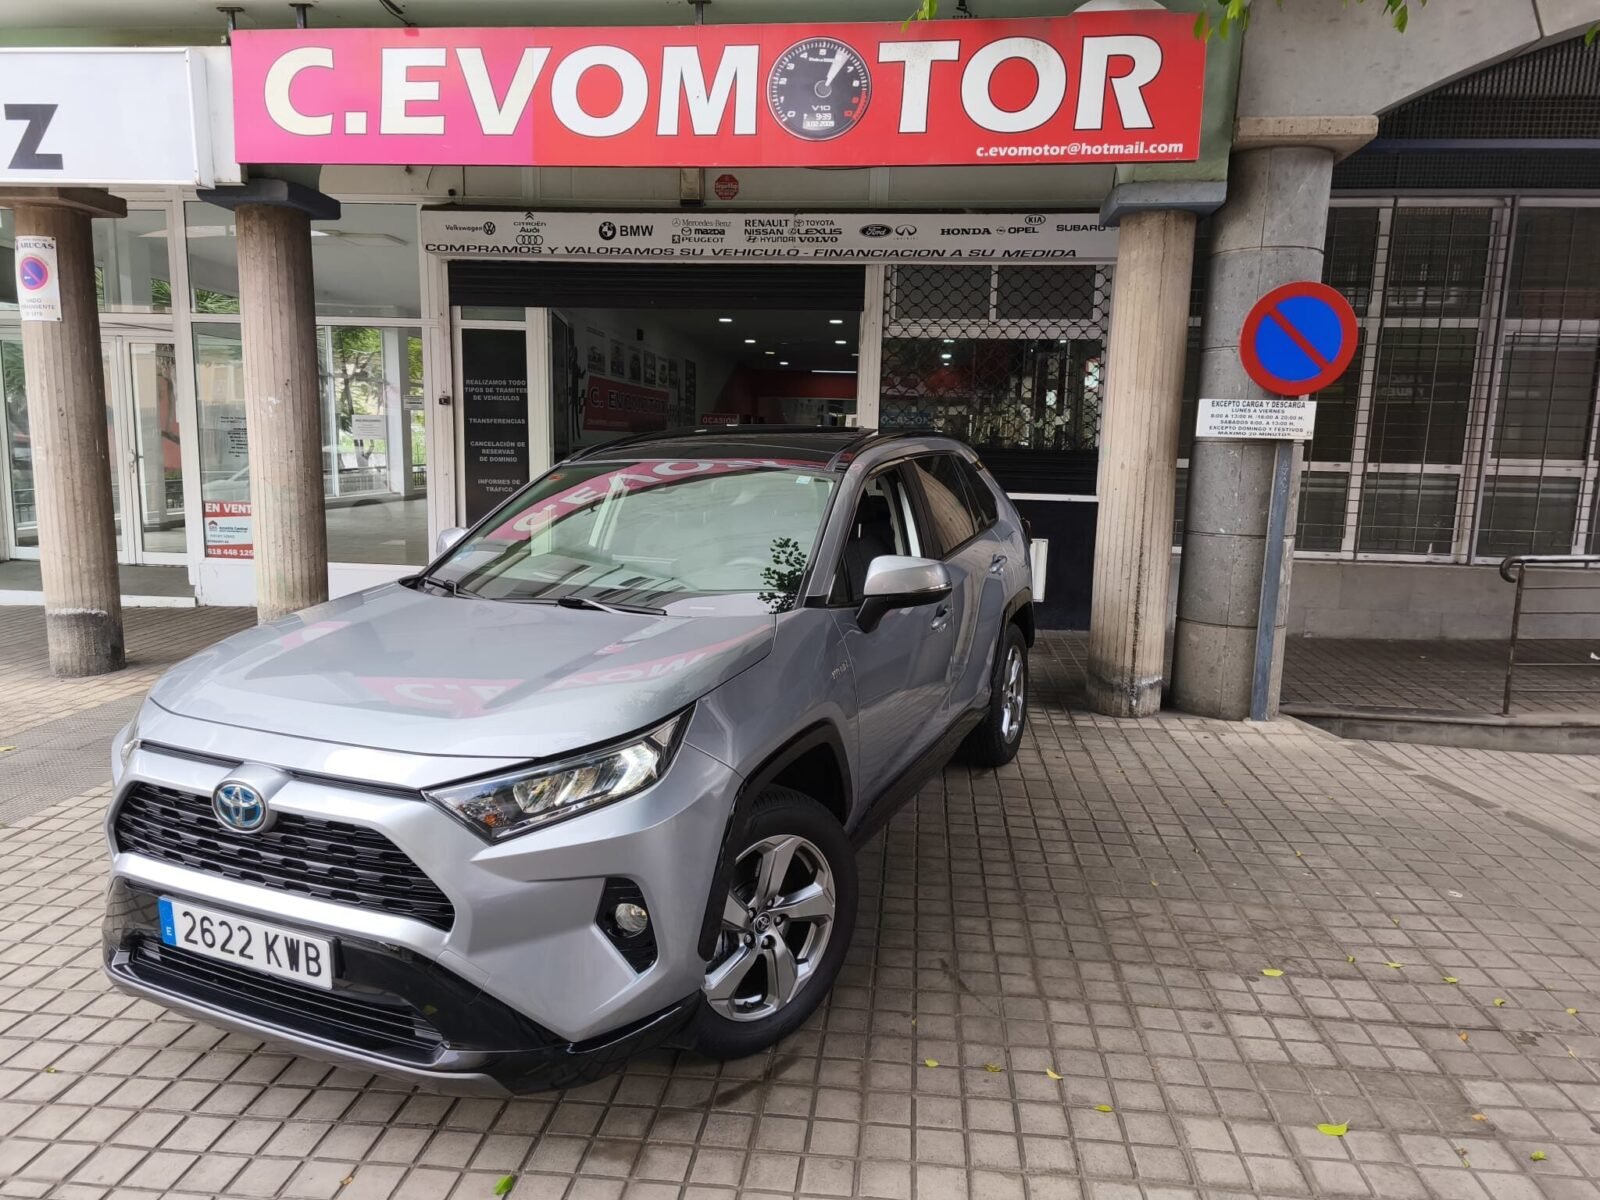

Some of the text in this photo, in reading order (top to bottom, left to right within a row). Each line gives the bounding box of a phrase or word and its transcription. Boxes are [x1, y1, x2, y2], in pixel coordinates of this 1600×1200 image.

[4, 103, 64, 170] Z
[976, 141, 1184, 157] c.evomotor@hotmail.com
[681, 218, 731, 228] Mercedes-Benz
[744, 219, 790, 227] RENAULT
[805, 219, 835, 227] TOYOTA
[1027, 215, 1044, 224] KIA
[445, 223, 482, 233] Volkswagen
[619, 225, 654, 237] BMW
[694, 228, 725, 236] mazda
[744, 228, 784, 236] NISSAN
[797, 227, 843, 235] LEXUS
[940, 227, 992, 236] HONDA
[1007, 226, 1039, 234] OPEL
[681, 236, 724, 244] PEUGEOT
[425, 243, 542, 254] COMPRAMOS
[548, 246, 558, 255] Y
[565, 246, 675, 256] VALORAMOS
[680, 248, 704, 256] SU
[711, 248, 800, 257] VEHICULO
[813, 248, 946, 257] FINANCIACION
[950, 248, 963, 257] A
[968, 248, 996, 257] SU
[1001, 248, 1077, 258] MEDIDA
[1211, 400, 1240, 408] EXCEPTO
[1241, 400, 1264, 408] CARGA
[205, 502, 221, 513] EN
[165, 911, 322, 977] E 2622 KWB
